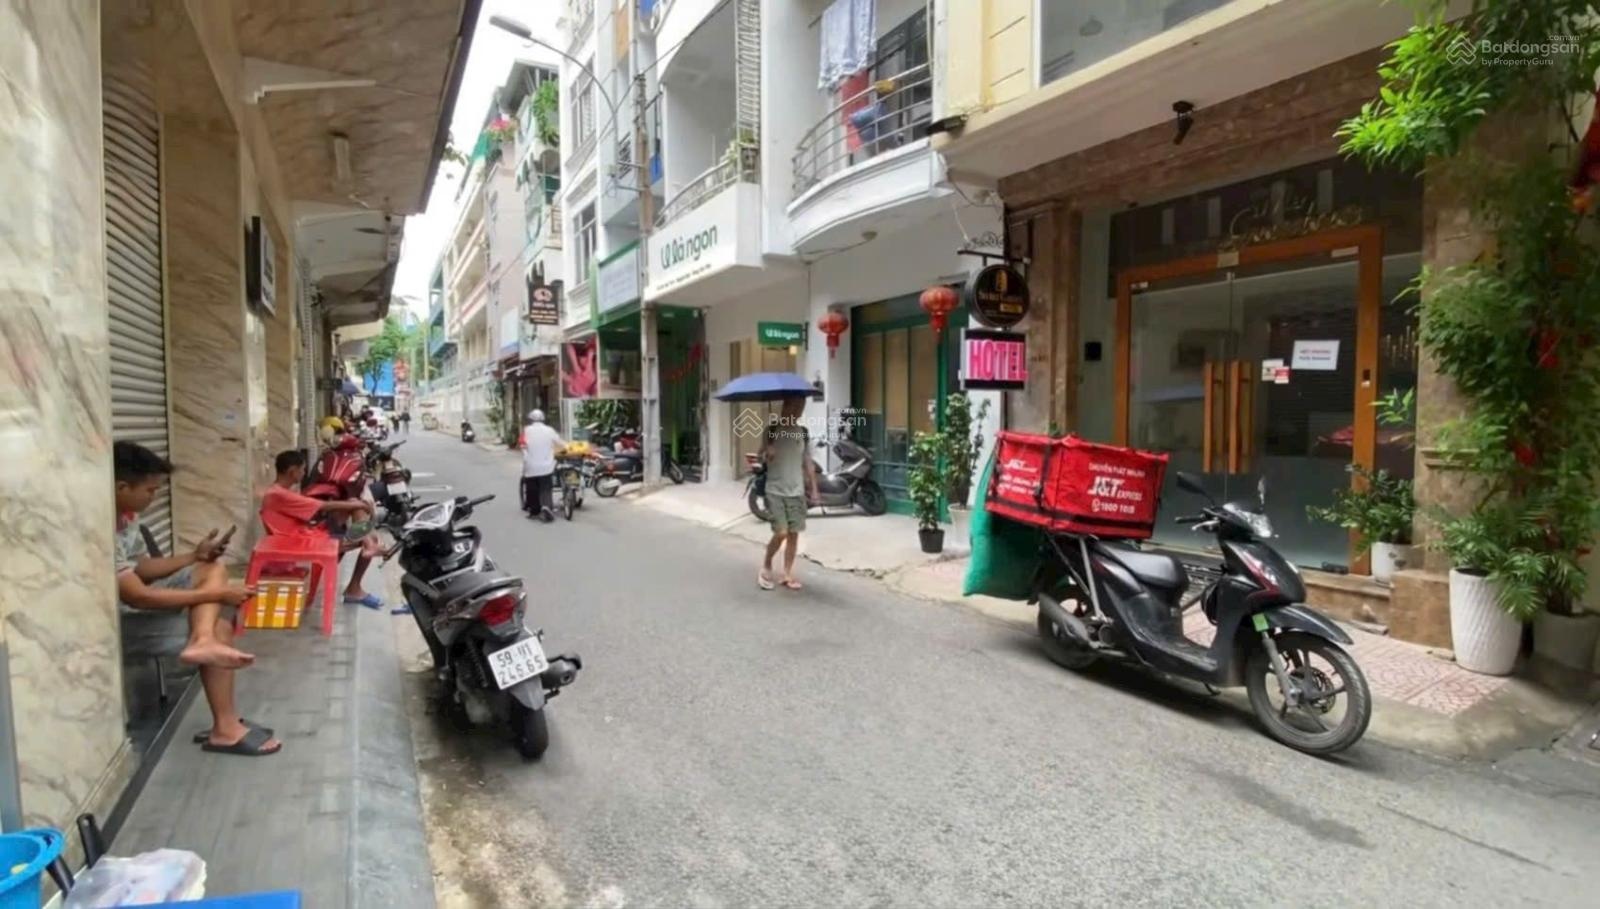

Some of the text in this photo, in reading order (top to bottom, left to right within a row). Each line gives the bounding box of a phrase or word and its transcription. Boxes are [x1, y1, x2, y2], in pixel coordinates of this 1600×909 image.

[686, 225, 718, 261] ngon
[966, 339, 1028, 383] HOTEL
[1087, 475, 1126, 498] J&T
